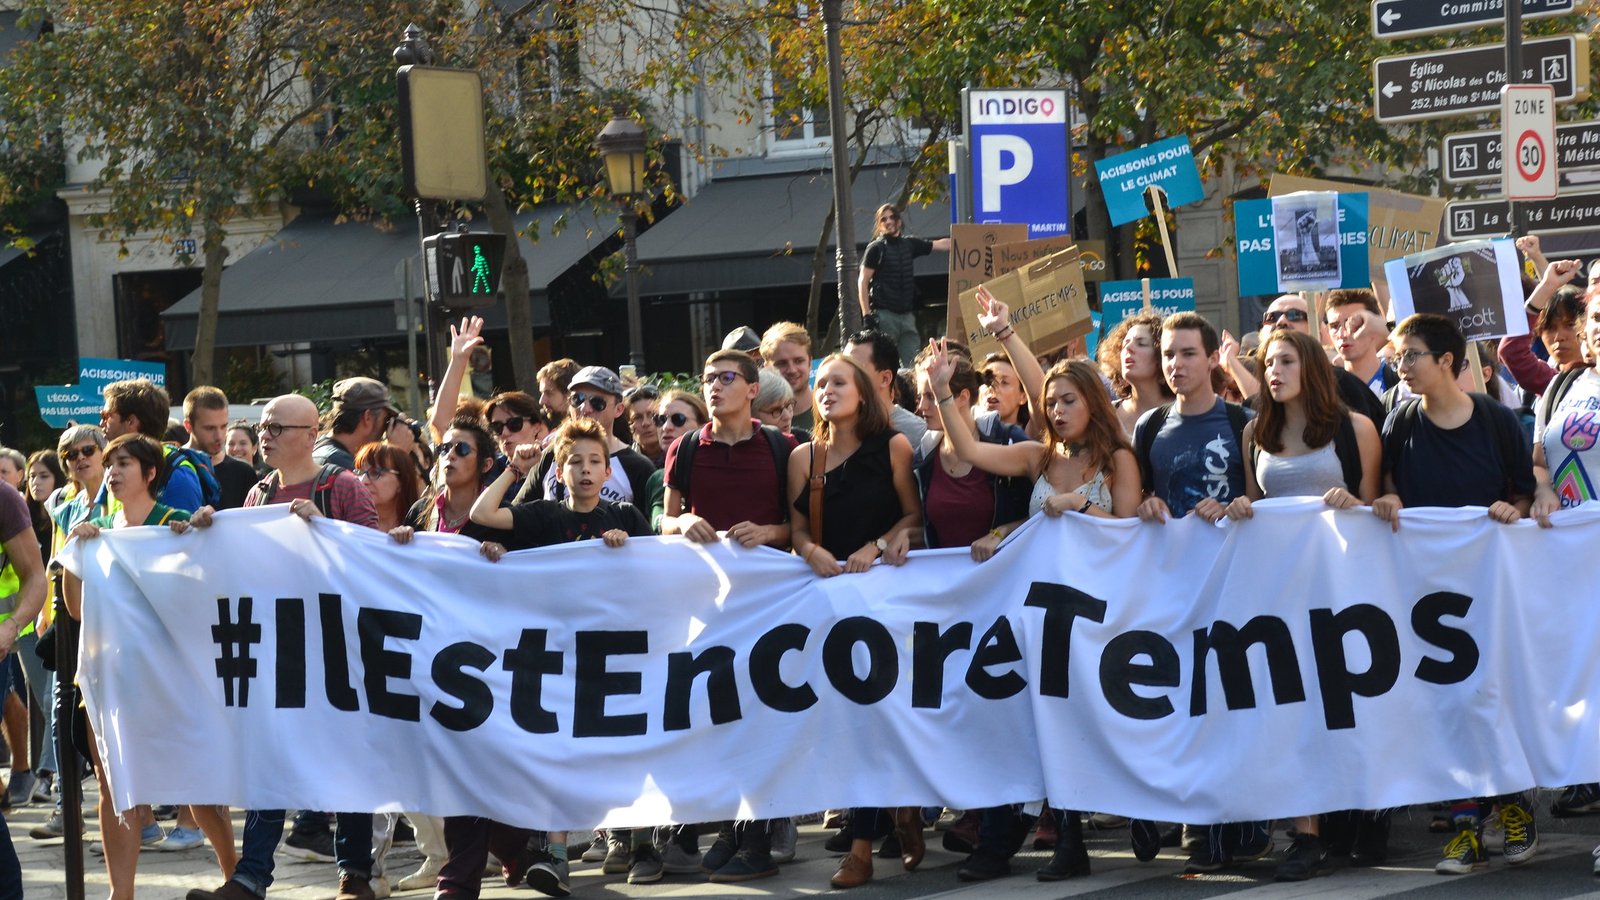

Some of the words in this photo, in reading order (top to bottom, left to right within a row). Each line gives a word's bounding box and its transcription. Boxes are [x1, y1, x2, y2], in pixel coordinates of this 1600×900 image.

[1410, 61, 1444, 79] Église
[1410, 81, 1423, 93] St
[1424, 76, 1467, 92] Nicolas
[1469, 77, 1483, 86] des
[980, 98, 1055, 117] INDIGO
[1410, 97, 1432, 110] 252,
[1434, 96, 1448, 107] bis
[1450, 94, 1468, 105] Rue
[1481, 90, 1500, 101] Mar
[1515, 100, 1545, 115] ZONE
[1581, 130, 1600, 145] Na
[1100, 155, 1157, 181] AGISSONS
[1157, 144, 1191, 163] POUR
[1522, 145, 1540, 167] 30
[980, 134, 1034, 213] P
[1121, 179, 1136, 192] LE
[1136, 165, 1178, 186] CLIMAT
[1483, 213, 1499, 226] La
[1551, 205, 1600, 222] Lyrique
[1031, 223, 1067, 232] MARTIN
[1239, 237, 1272, 253] PAS
[1369, 225, 1433, 252] CLIMAT
[953, 238, 981, 272] NO
[1162, 288, 1194, 299] POUR
[80, 368, 137, 380] AGISSONS
[40, 407, 56, 416] PAS
[56, 407, 69, 415] LES
[211, 582, 1479, 737] #IlEstEncoreTemps
